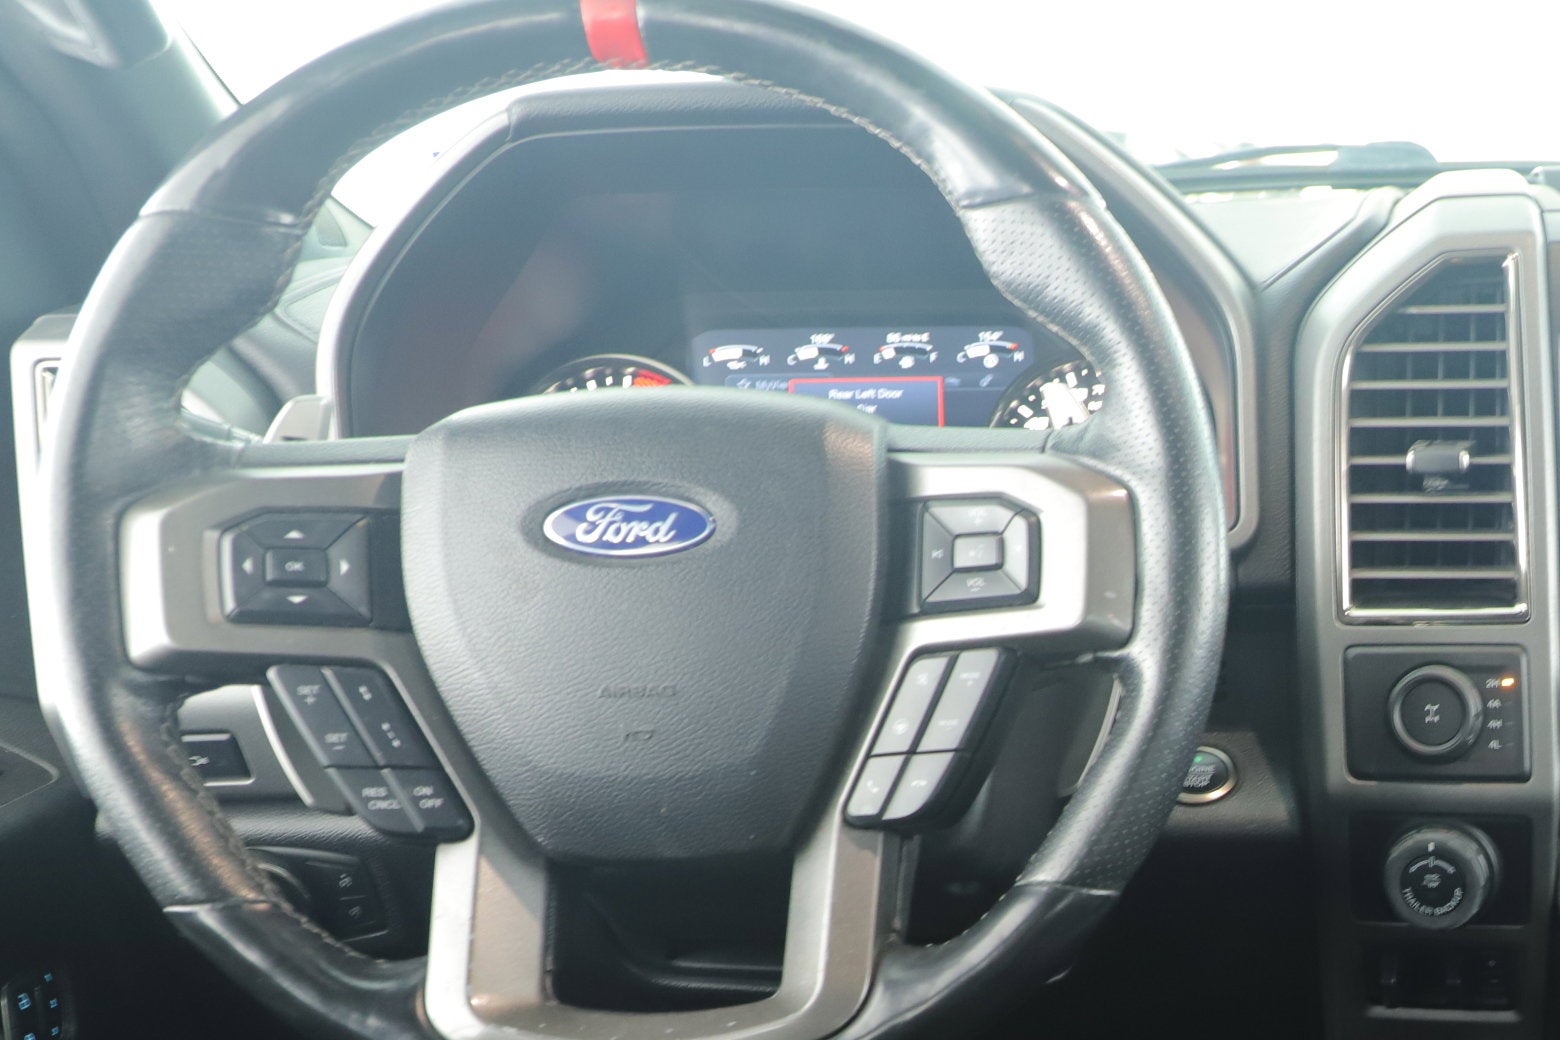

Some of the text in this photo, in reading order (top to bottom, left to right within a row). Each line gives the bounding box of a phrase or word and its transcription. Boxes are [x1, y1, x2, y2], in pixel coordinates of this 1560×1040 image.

[828, 388, 904, 399] Rear Left Door
[575, 503, 679, 544] Ford
[362, 787, 387, 797] RES
[413, 786, 433, 796] ON
[419, 799, 443, 809] OFF
